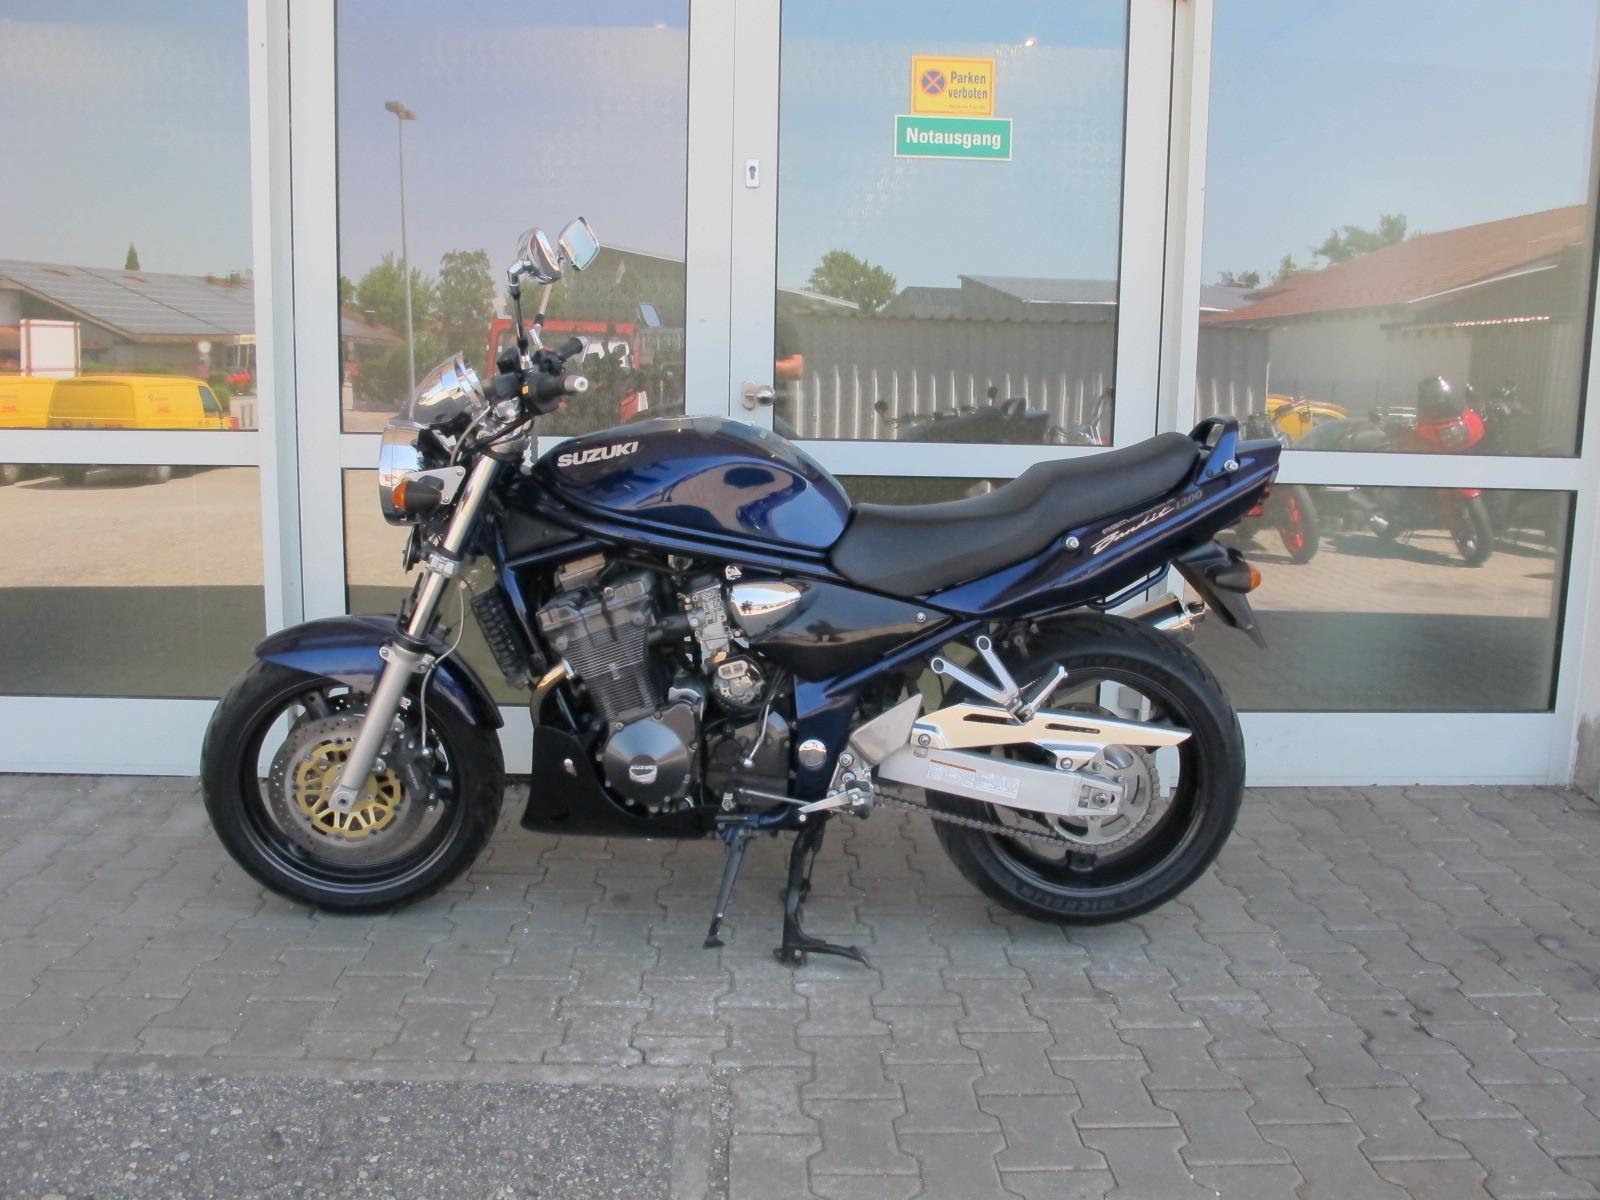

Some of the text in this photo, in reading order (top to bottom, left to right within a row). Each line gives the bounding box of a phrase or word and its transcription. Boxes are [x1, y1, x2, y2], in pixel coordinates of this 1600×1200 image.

[950, 70, 986, 85] Parken
[948, 87, 988, 100] verboten
[906, 127, 1001, 149] Notausgang
[557, 441, 639, 467] SUZUKI
[1175, 489, 1203, 510] 1200
